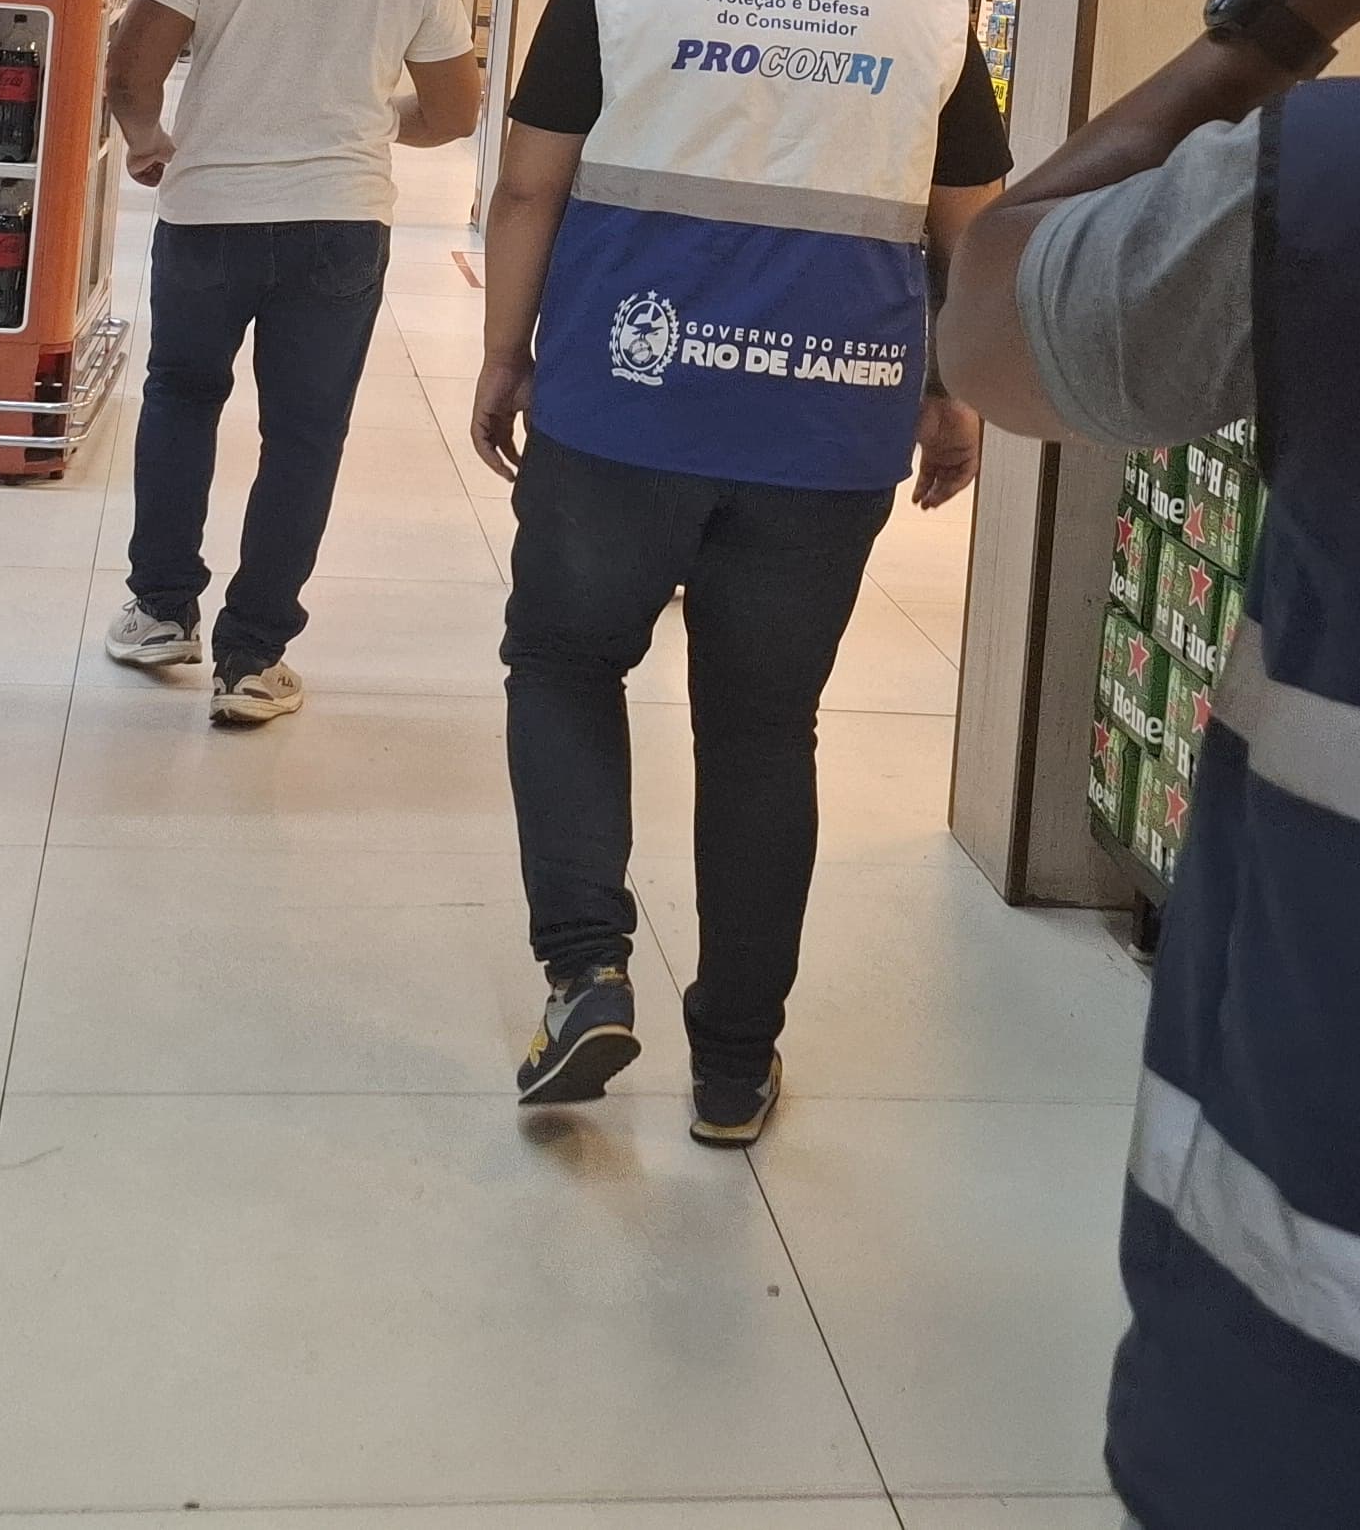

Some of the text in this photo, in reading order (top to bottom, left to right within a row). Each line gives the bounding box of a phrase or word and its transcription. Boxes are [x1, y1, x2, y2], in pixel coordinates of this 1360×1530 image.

[717, 10, 859, 37] do Consumidor
[685, 321, 908, 359] GOVERNO DO ESTADO
[680, 338, 903, 387] RIO DE JANEIRO
